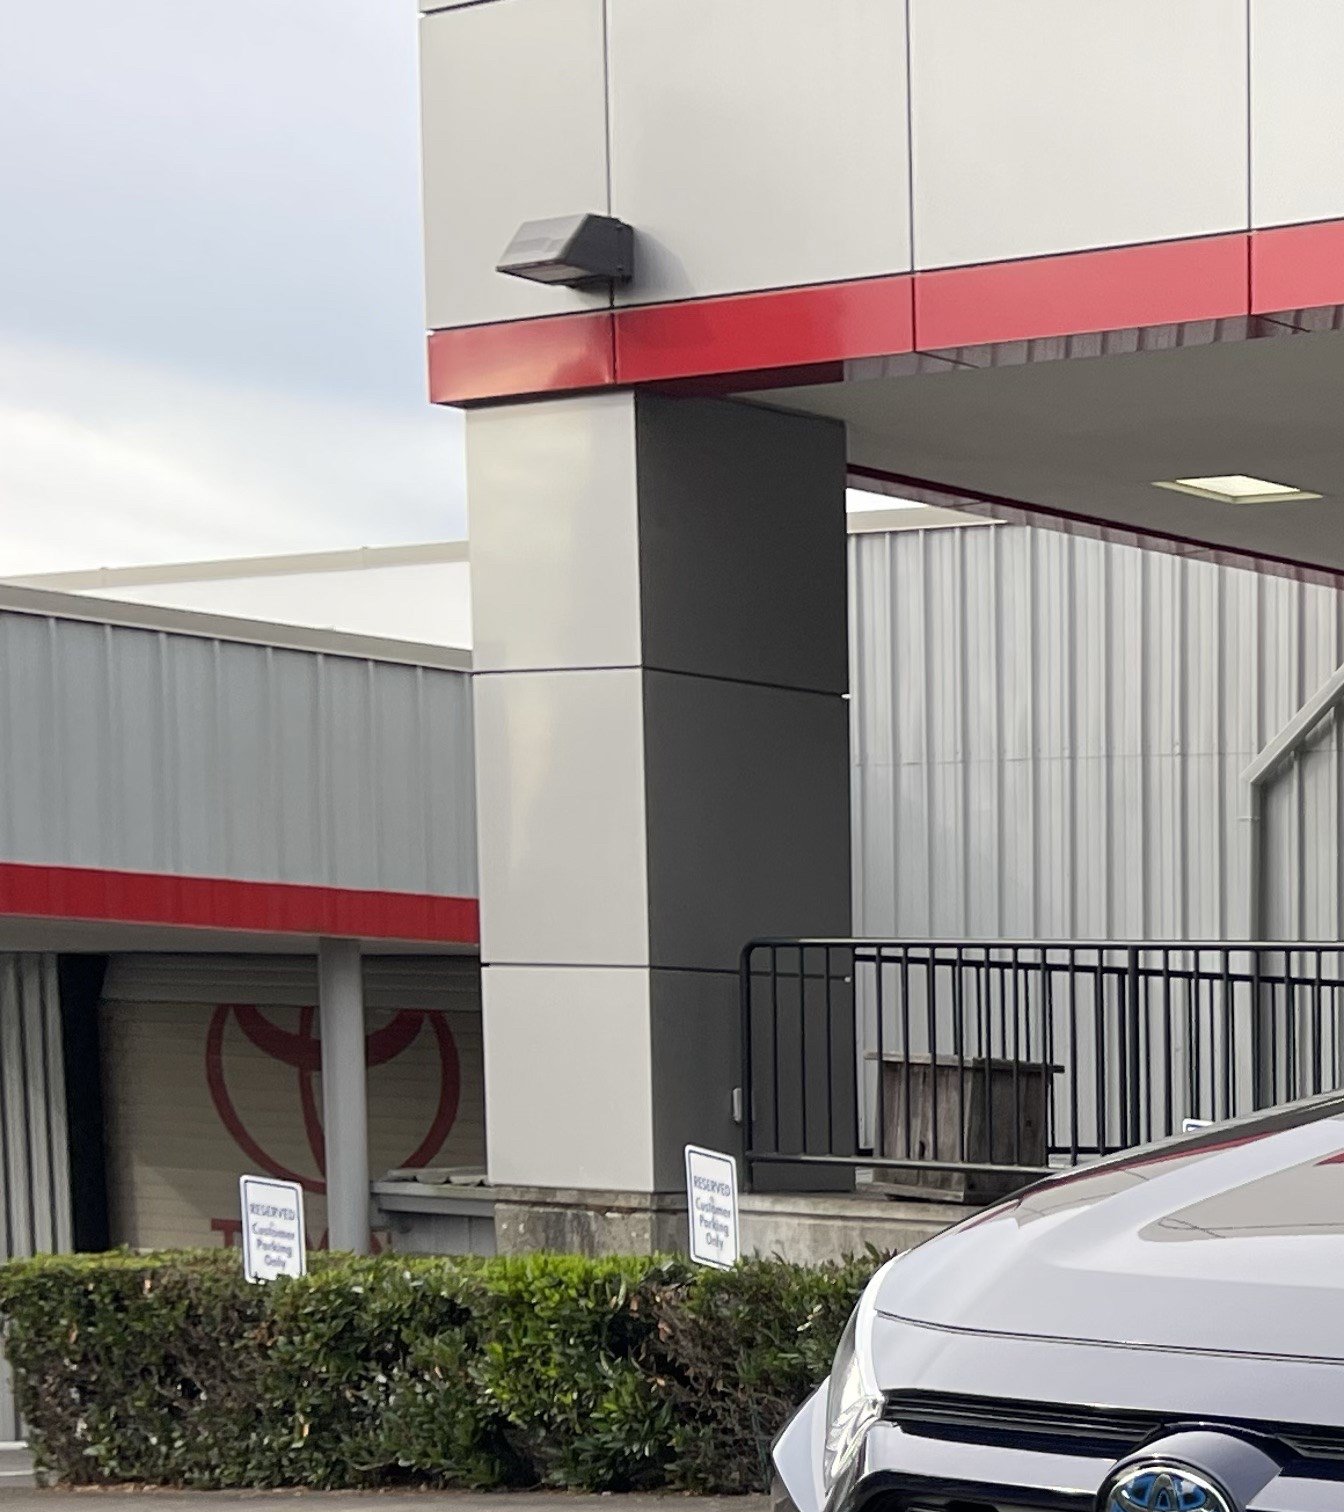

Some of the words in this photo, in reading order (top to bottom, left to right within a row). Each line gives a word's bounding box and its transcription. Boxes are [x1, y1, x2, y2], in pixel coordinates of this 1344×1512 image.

[693, 1175, 731, 1197] RESERVED
[250, 1203, 295, 1220] RESERVED
[695, 1197, 731, 1217] Customer
[252, 1222, 295, 1239] Customer
[699, 1214, 729, 1237] Parking
[257, 1239, 293, 1258] Parking
[705, 1232, 724, 1250] Only
[264, 1254, 286, 1270] Only
